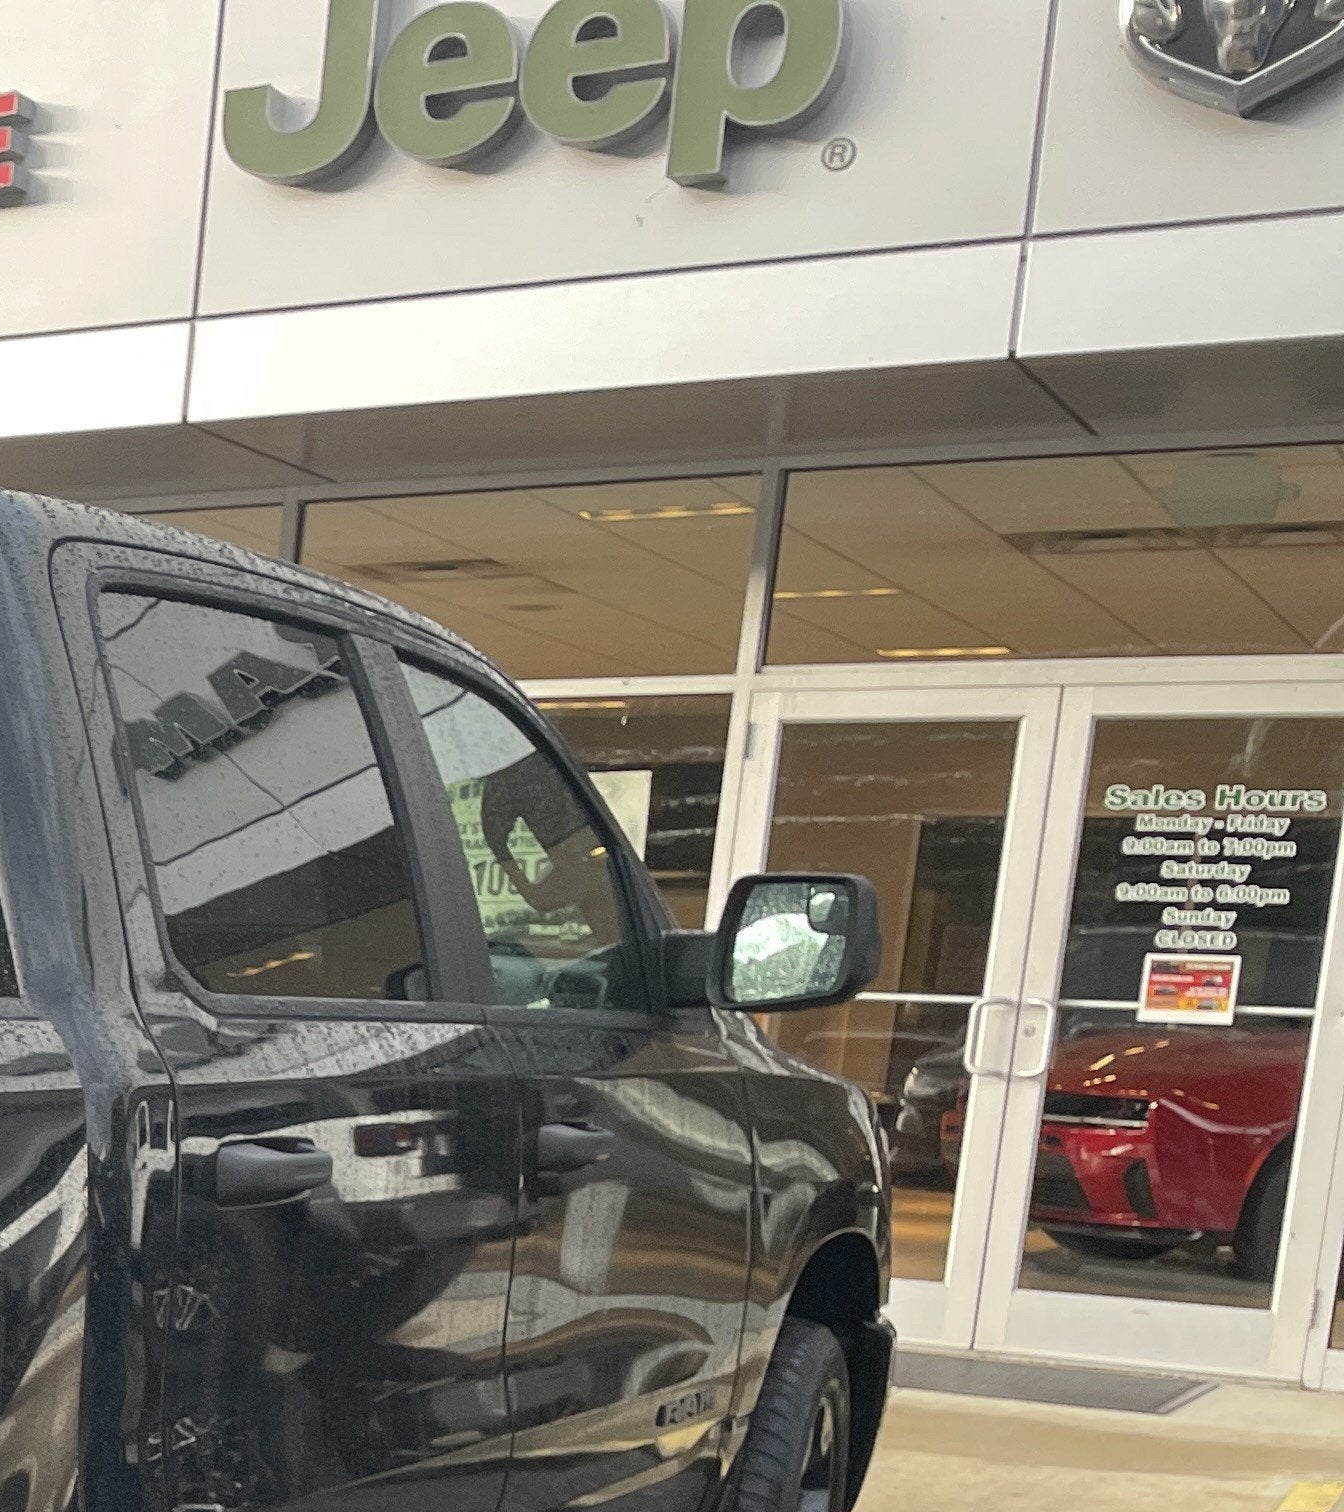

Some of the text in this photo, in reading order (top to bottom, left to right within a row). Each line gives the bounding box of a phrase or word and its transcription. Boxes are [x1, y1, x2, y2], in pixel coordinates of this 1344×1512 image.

[221, 0, 846, 187] Jeep
[1106, 784, 1327, 812] Sales Hours
[1135, 813, 1213, 836] Monday
[1226, 813, 1291, 837] Friday
[1197, 837, 1221, 856] to
[1160, 860, 1252, 883] Saturday
[1190, 884, 1214, 902] to
[1162, 906, 1238, 930] Sunday
[1154, 930, 1238, 950] CLOSED
